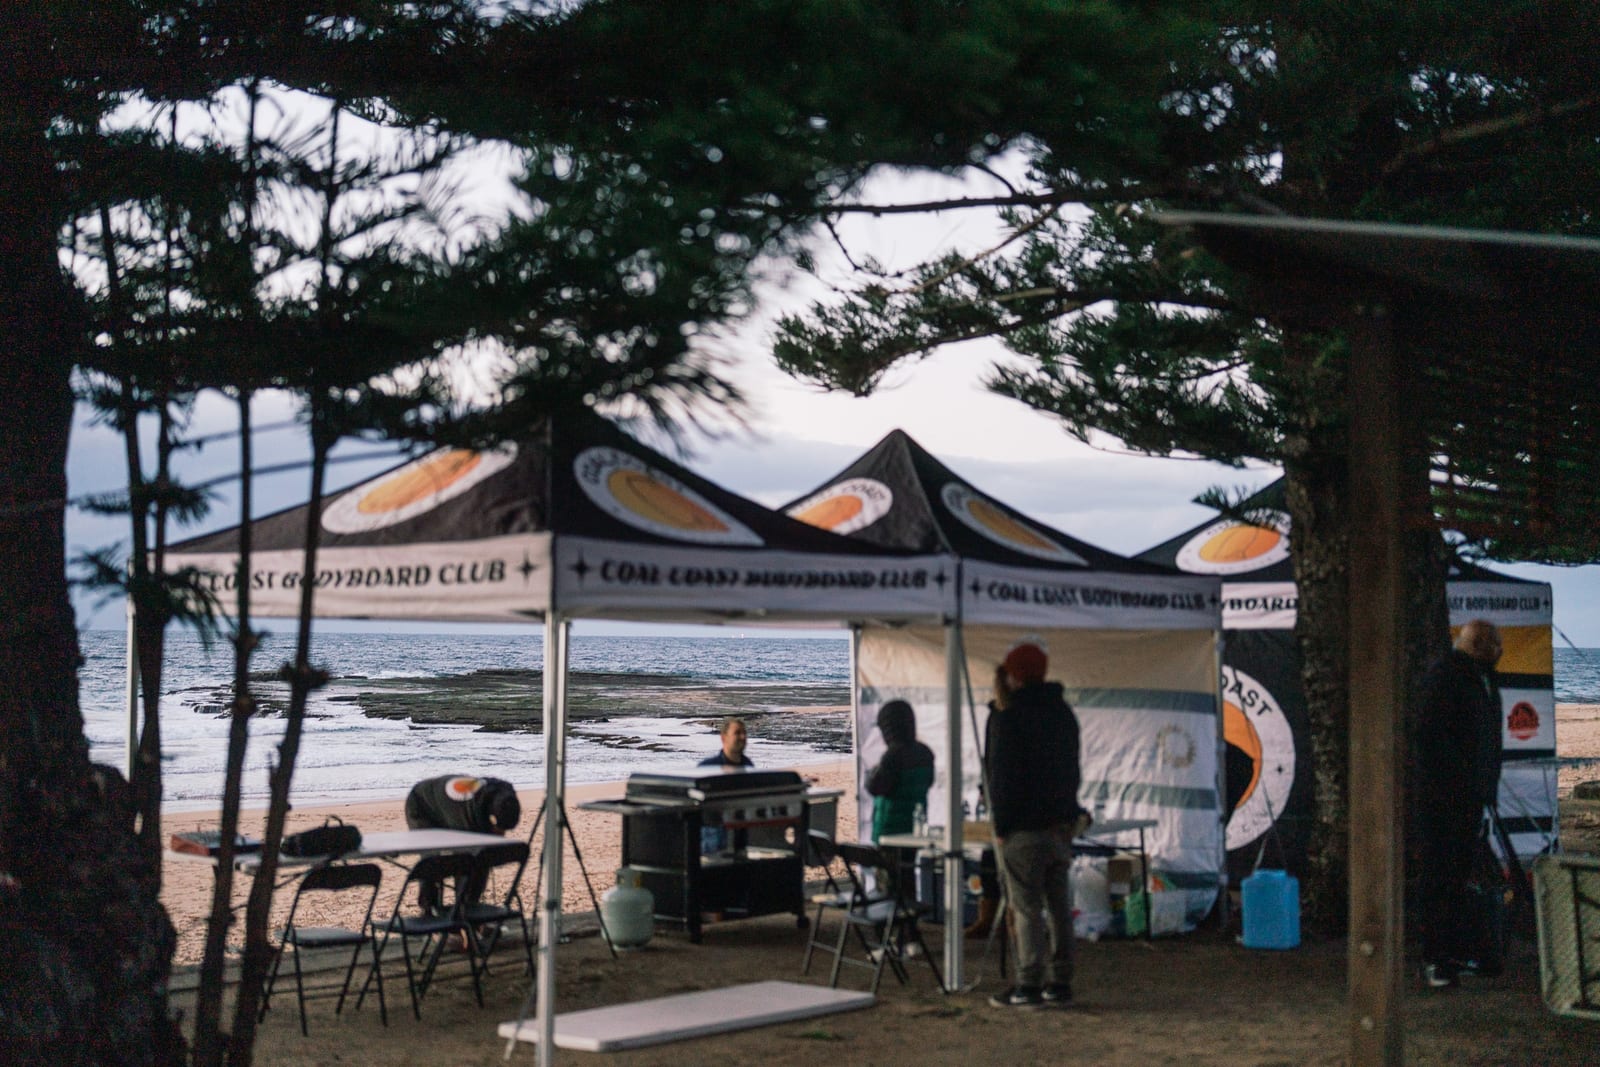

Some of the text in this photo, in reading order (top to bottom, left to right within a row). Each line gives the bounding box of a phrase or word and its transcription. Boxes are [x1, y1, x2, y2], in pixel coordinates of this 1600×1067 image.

[209, 570, 277, 592] COST
[281, 565, 431, 590] BDYBOARD
[439, 560, 506, 584] CLUB
[600, 559, 662, 585] COAL
